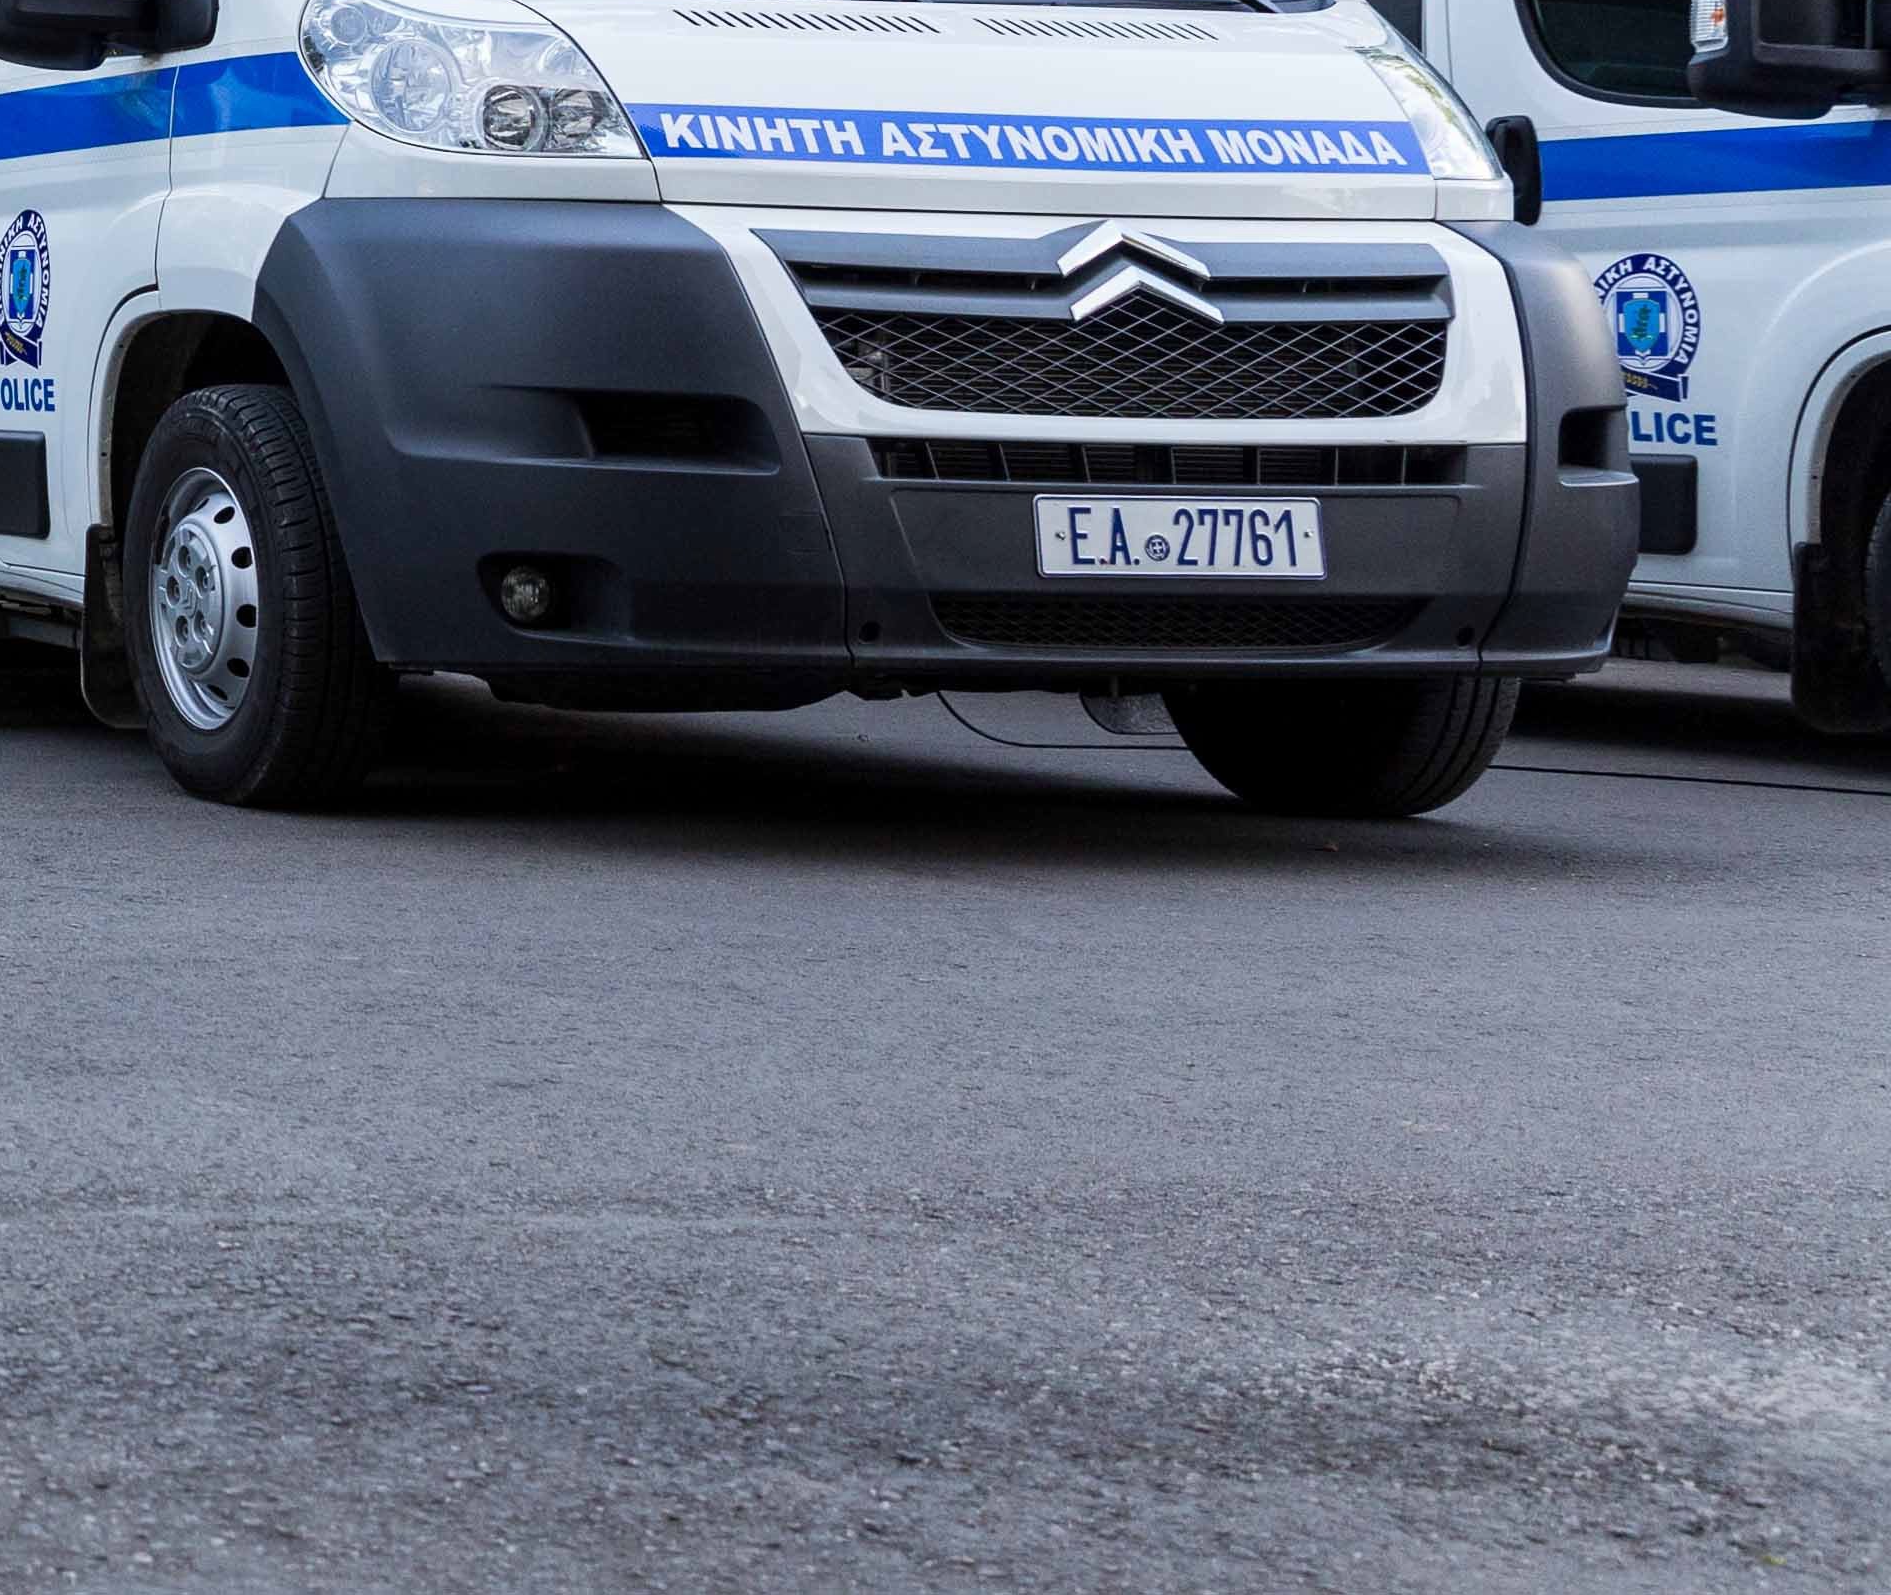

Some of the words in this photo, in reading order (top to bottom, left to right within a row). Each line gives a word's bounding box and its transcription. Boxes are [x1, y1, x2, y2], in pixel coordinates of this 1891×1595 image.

[660, 113, 866, 156] ΚΙΝΗΤΗ
[881, 121, 1205, 164] ΑΣΤΥΝΟΜΙΚΗ
[1218, 128, 1409, 168] ΜΟΝΑΔΑ
[1642, 256, 1699, 364] ΑΣΤΥΝΟΜΙΑ
[1630, 410, 1718, 446] LICE
[1172, 507, 1297, 568] 27761
